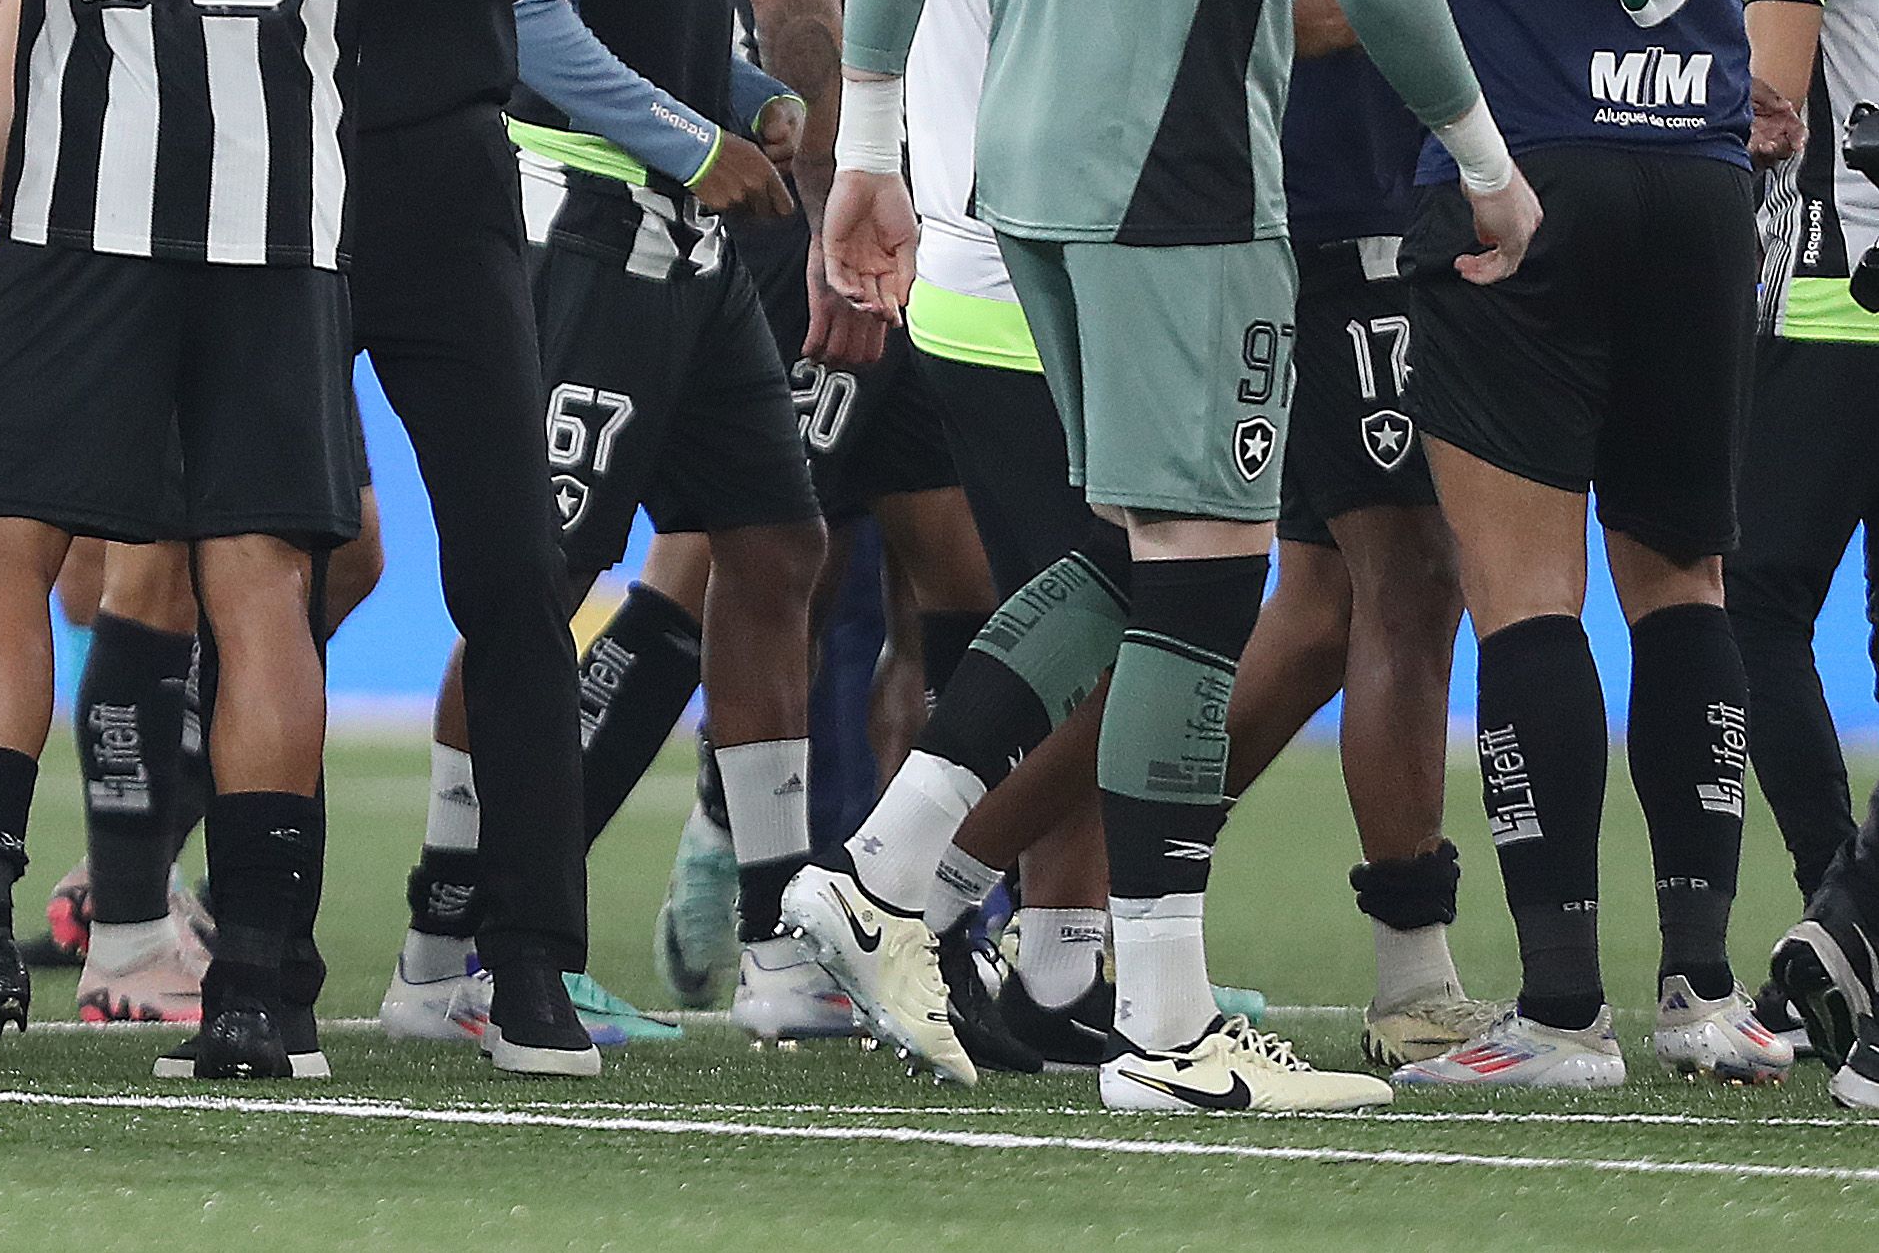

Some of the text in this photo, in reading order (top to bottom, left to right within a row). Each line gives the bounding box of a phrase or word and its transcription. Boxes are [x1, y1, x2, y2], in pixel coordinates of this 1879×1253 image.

[650, 102, 710, 143] Reebok
[1666, 116, 1706, 128] carros
[1803, 199, 1823, 265] Reebok
[1346, 315, 1413, 399] 17
[546, 383, 634, 472] 67
